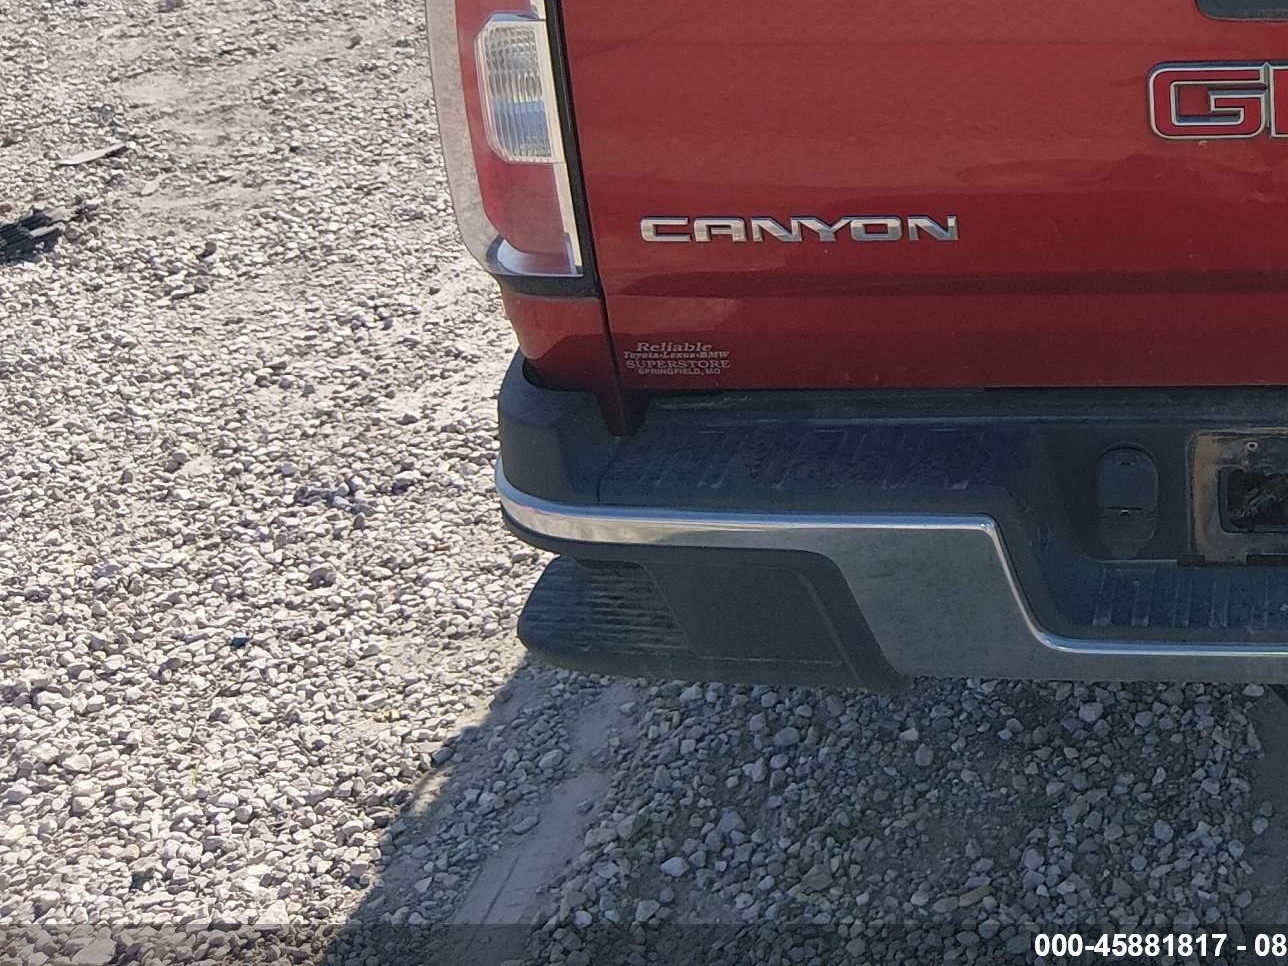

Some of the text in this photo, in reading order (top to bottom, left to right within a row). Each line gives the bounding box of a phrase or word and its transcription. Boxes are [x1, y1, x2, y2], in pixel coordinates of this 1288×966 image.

[640, 215, 960, 243] CANYON
[636, 342, 713, 352] Reliable
[625, 359, 732, 369] SUPERSTORE
